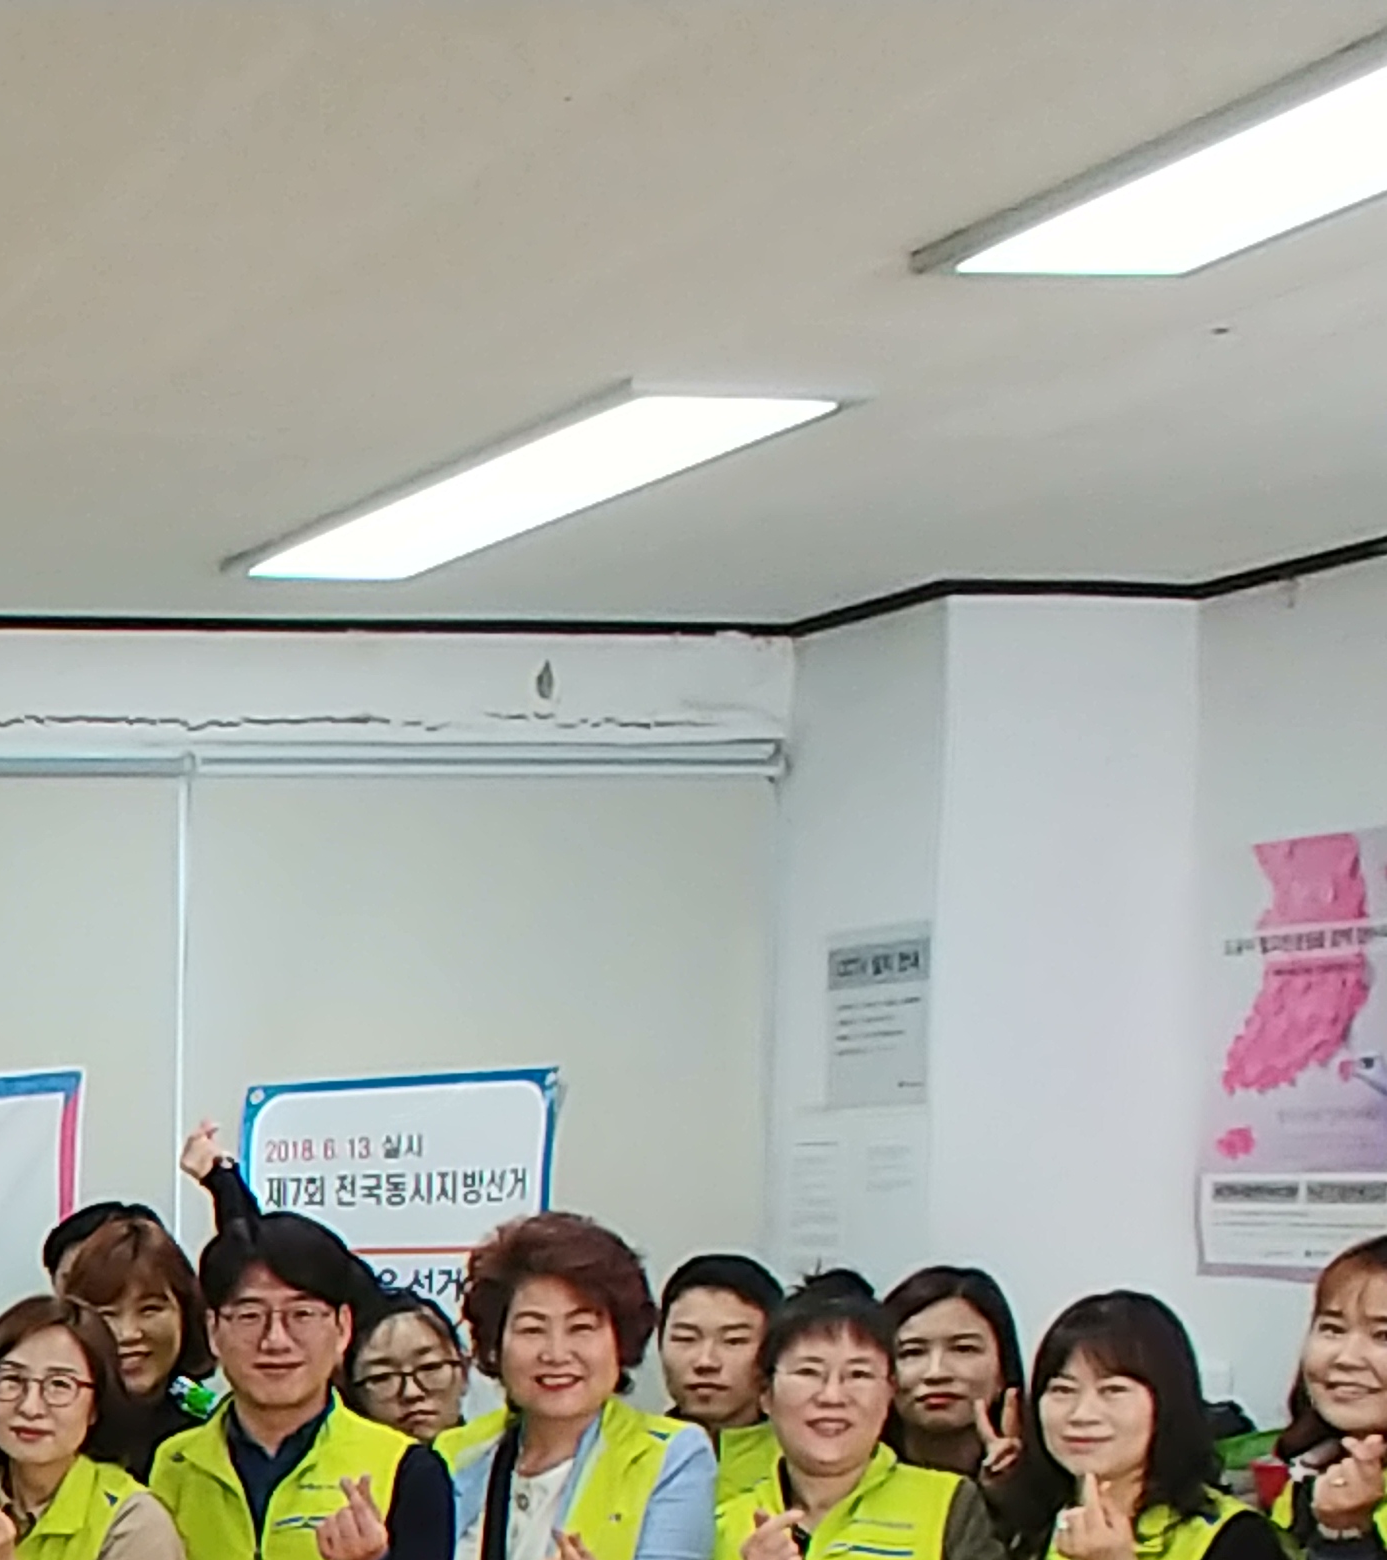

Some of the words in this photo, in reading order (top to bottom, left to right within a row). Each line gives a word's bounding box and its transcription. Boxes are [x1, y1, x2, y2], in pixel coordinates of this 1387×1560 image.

[382, 1133, 423, 1160] 실시
[265, 1174, 325, 1208] 제7회
[336, 1167, 527, 1207] 전국동시지방선거
